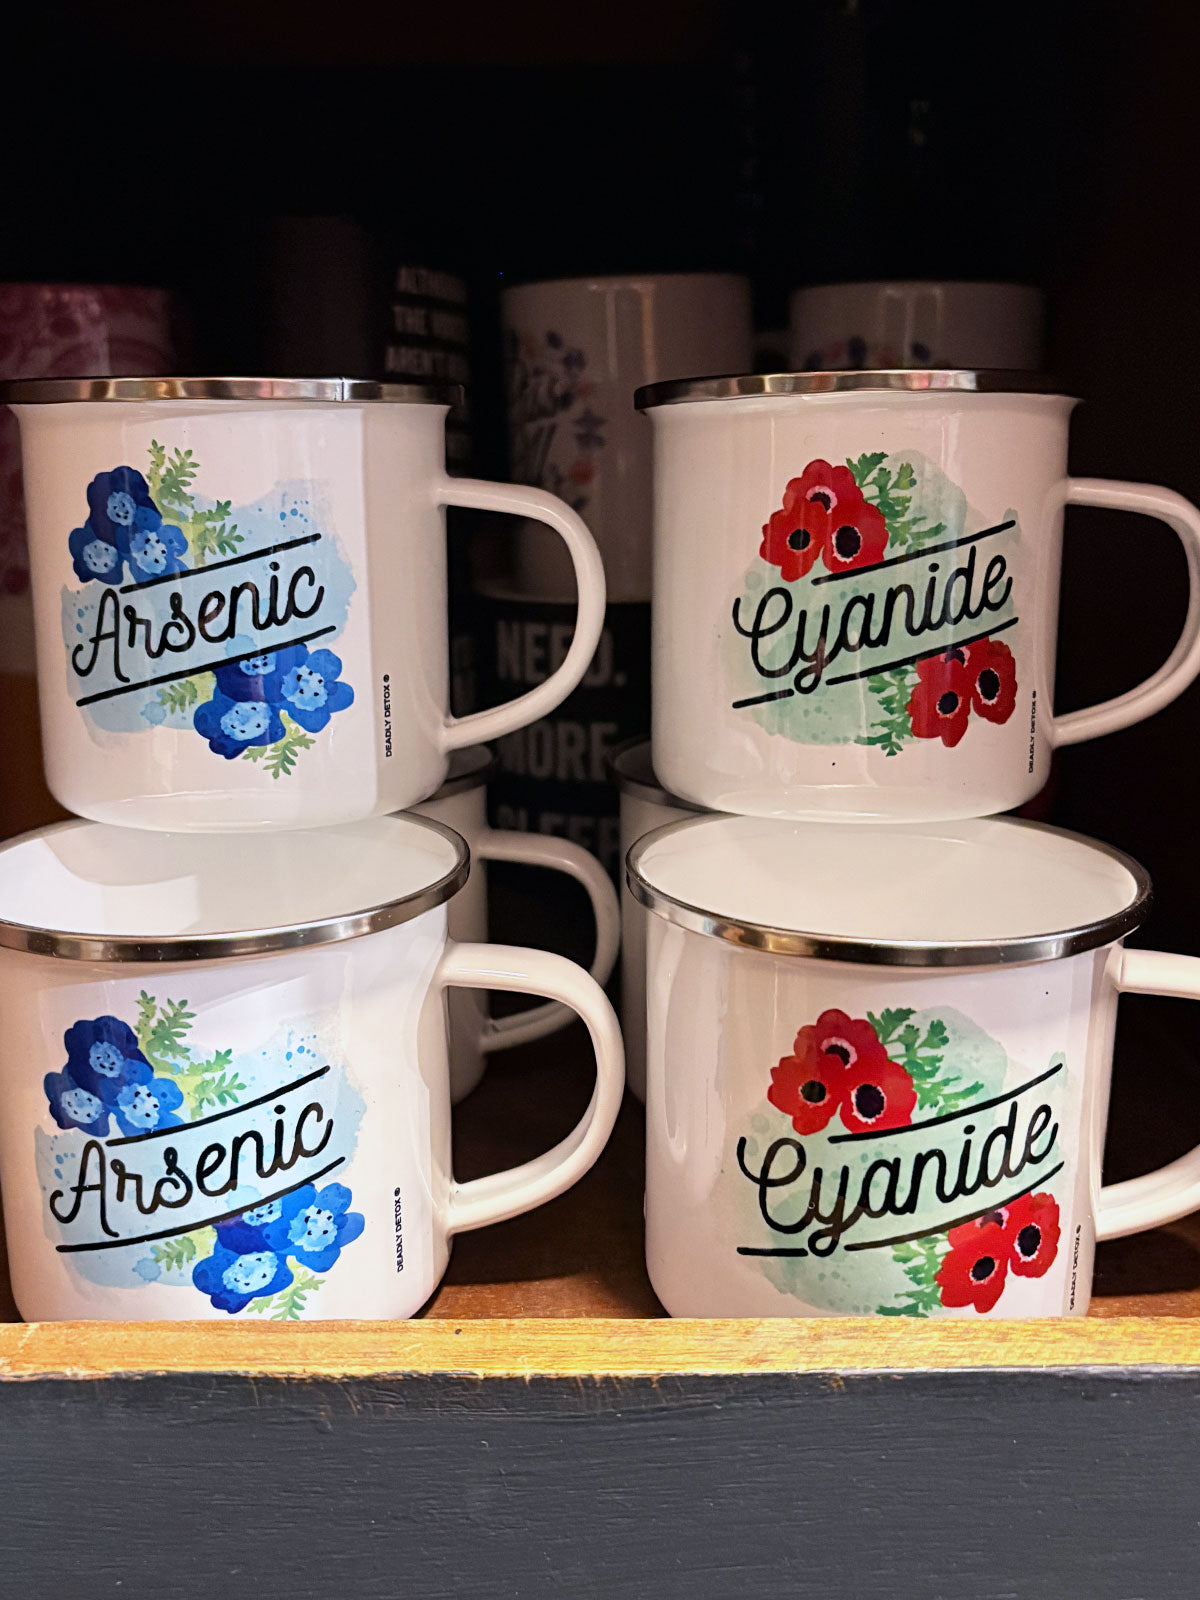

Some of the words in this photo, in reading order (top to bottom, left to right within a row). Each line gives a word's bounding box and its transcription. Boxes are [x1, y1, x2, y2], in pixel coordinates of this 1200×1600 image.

[72, 562, 324, 683] Arsenic
[732, 545, 1013, 694] Cyanide
[383, 684, 391, 718] DETOX
[384, 719, 392, 758] DEADLY
[50, 1102, 333, 1238] Arsenic
[737, 1101, 1059, 1257] Cyanide
[394, 1197, 402, 1233] DETOX
[395, 1233, 404, 1273] DEADLY
